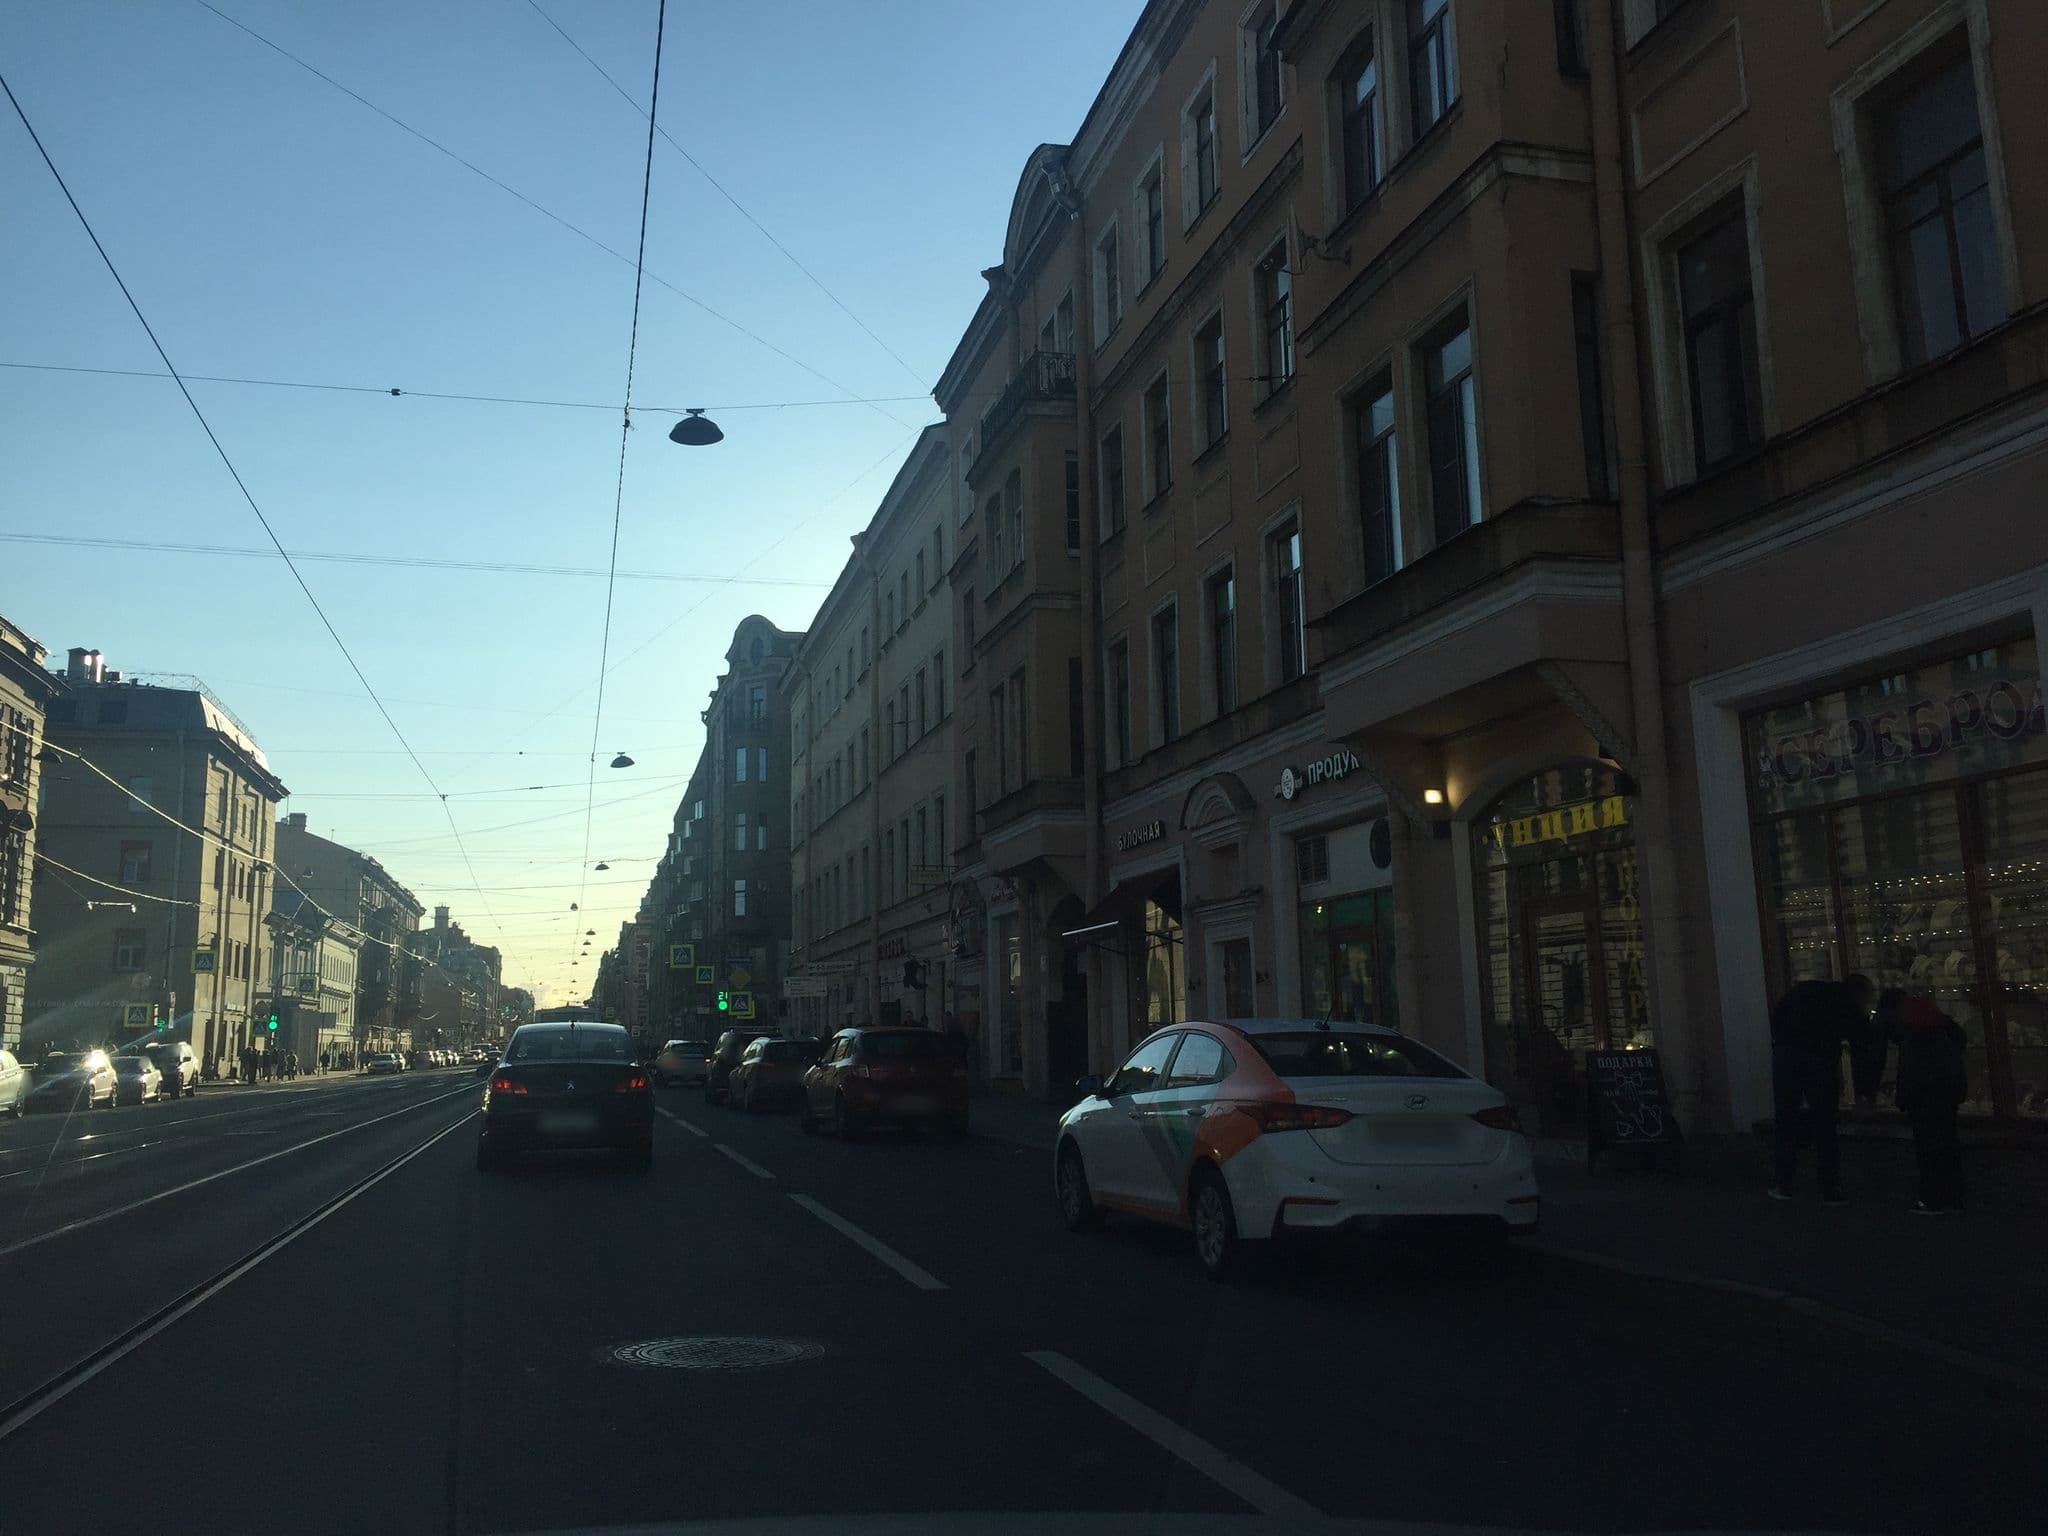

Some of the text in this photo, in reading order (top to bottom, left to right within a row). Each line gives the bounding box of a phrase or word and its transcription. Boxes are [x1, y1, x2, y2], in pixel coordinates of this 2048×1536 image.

[1775, 679, 2027, 785] СЕРЕБРО
[1119, 820, 1160, 851] БУЛОЧНАЯ
[1490, 795, 1629, 847] УНЦИЯ
[718, 991, 728, 1000] 21
[1597, 1054, 1656, 1071] ПОДАРКИ
